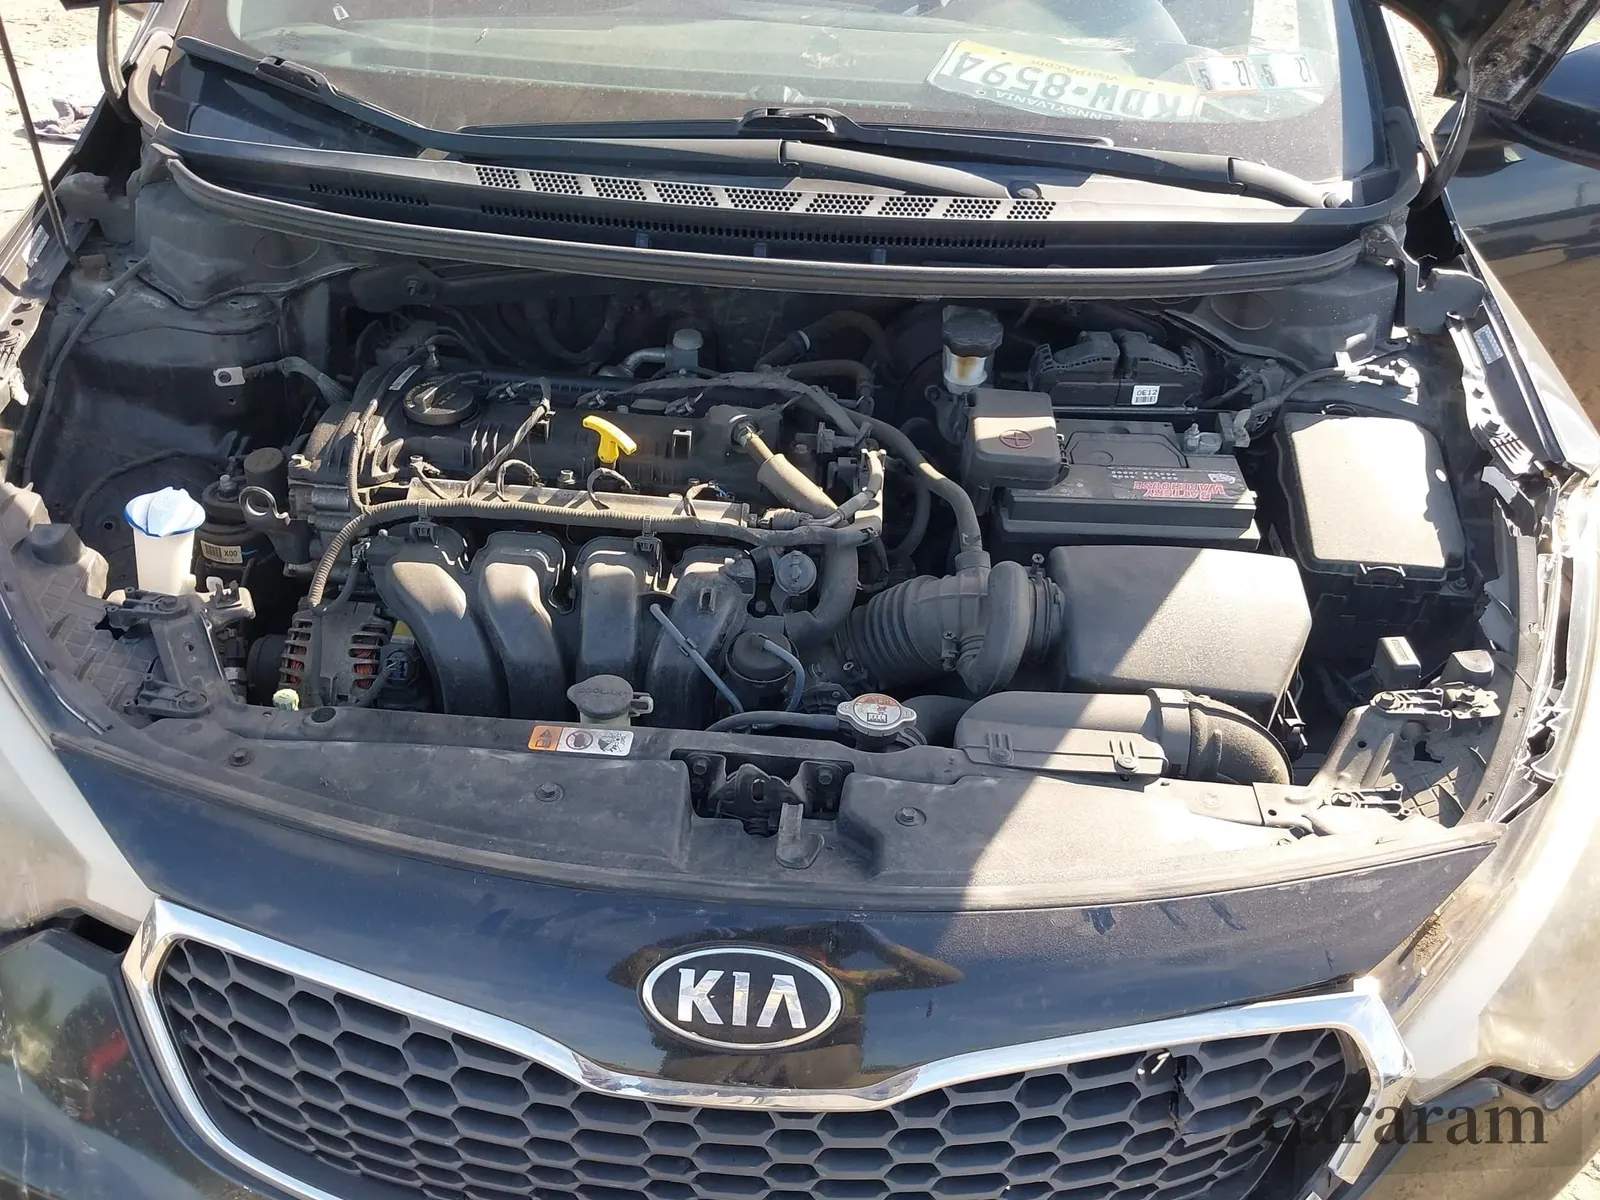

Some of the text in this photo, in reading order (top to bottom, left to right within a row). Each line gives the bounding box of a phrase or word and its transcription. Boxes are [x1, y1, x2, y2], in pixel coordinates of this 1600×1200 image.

[1133, 480, 1226, 495] WAREHOUSE
[1143, 487, 1212, 502] BATTERY
[677, 967, 807, 1029] KIA
